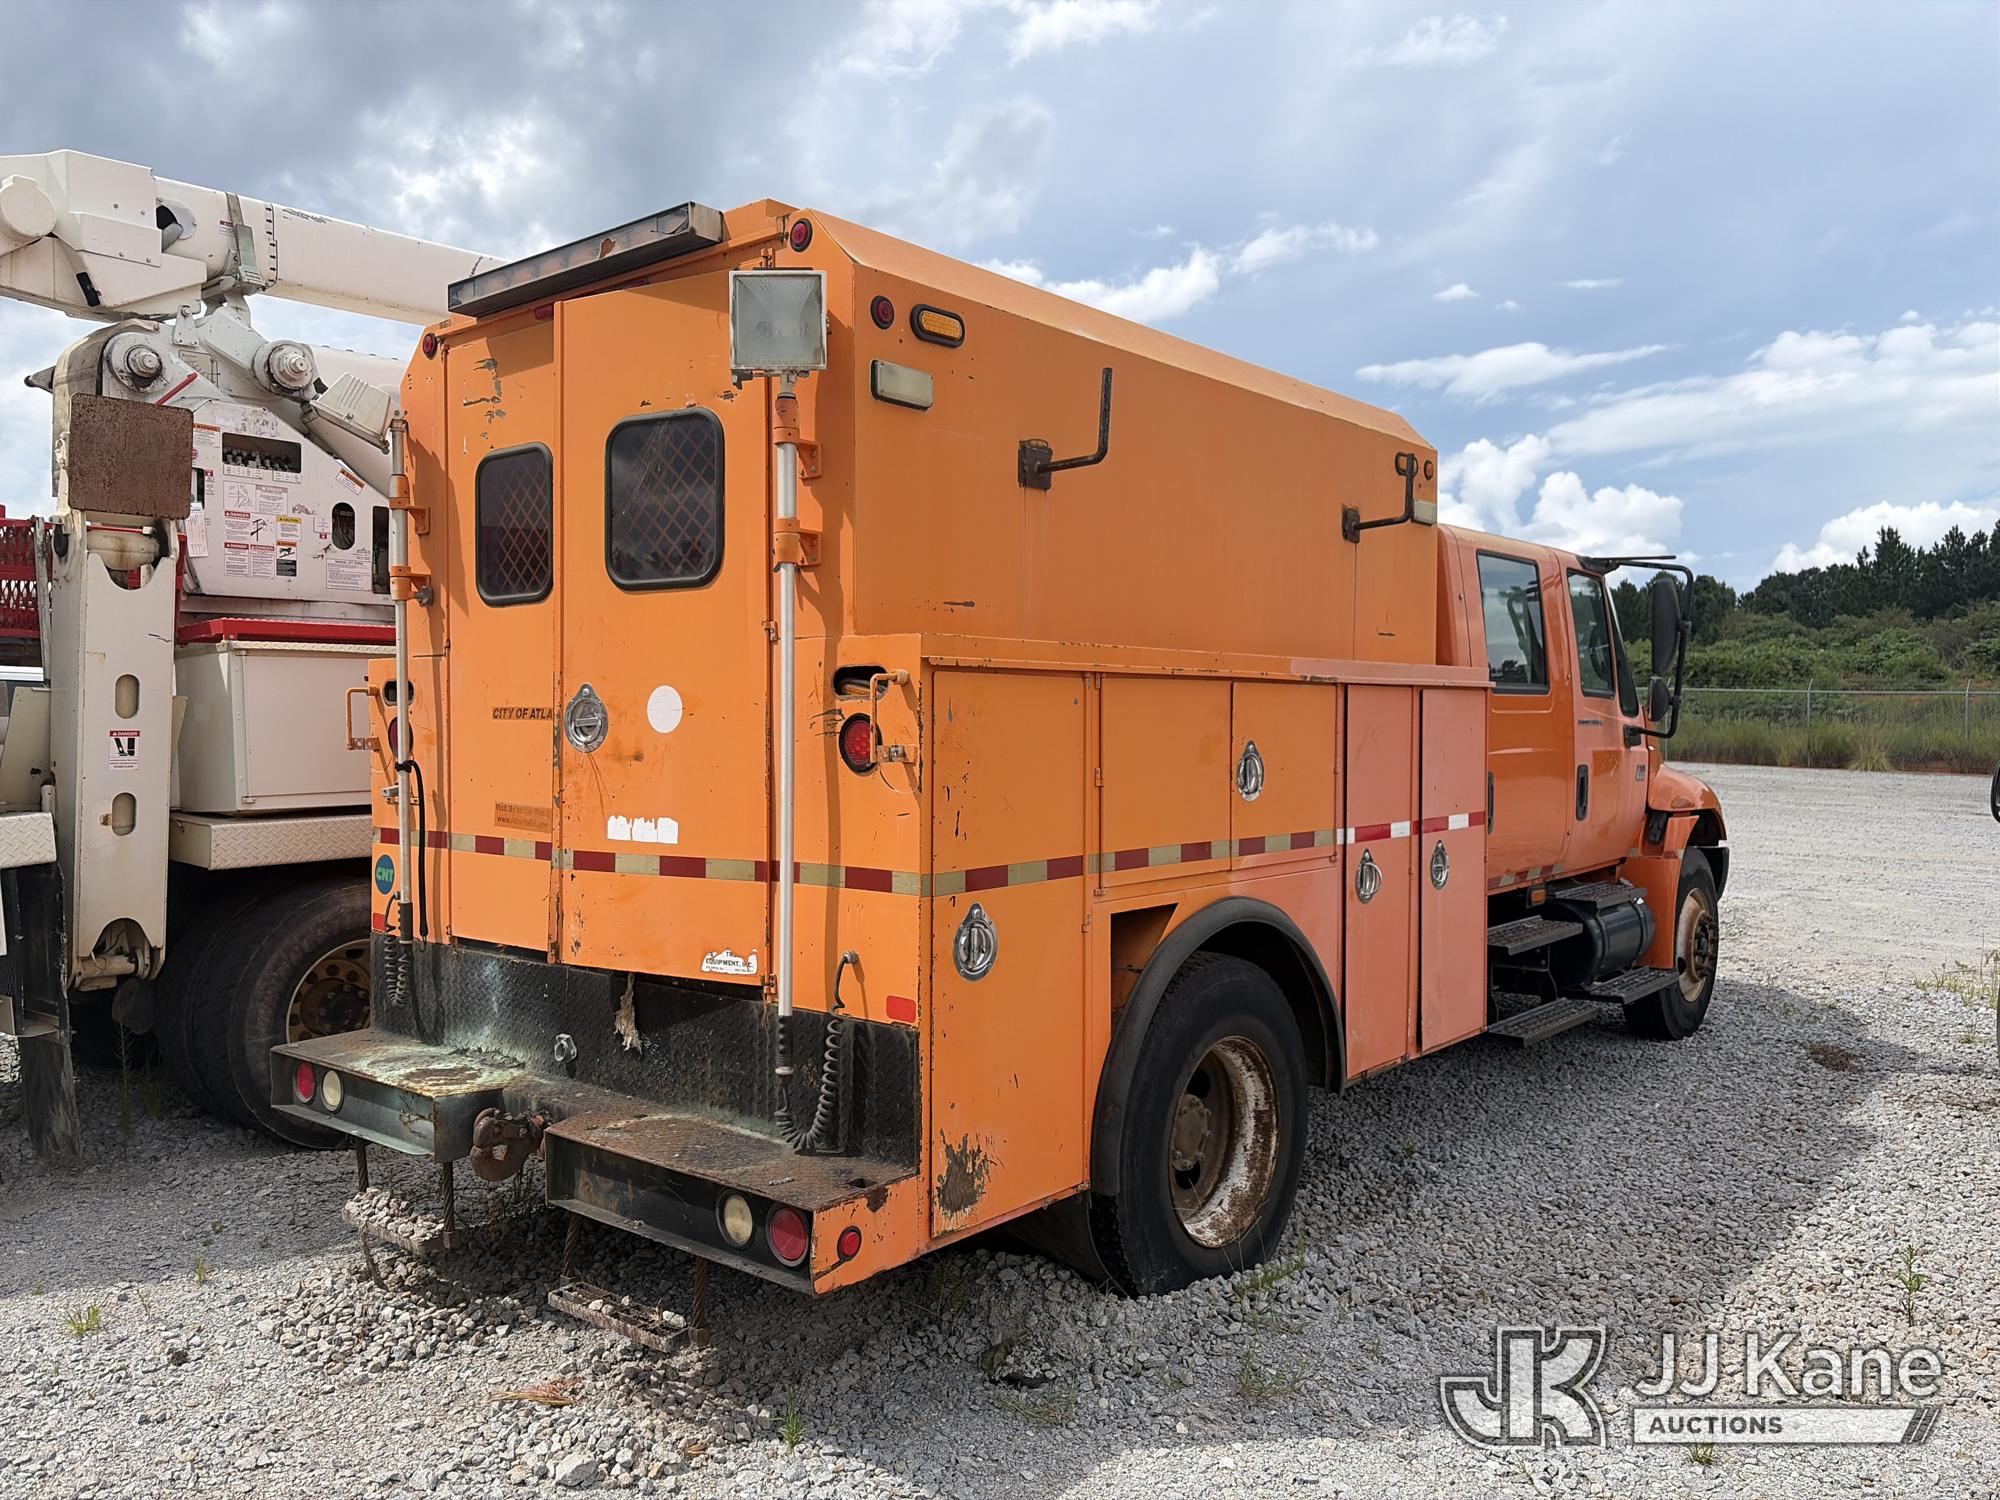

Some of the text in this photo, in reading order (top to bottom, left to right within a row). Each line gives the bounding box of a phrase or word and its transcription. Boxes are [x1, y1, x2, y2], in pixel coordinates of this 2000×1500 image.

[493, 708, 552, 720] CITY OF ATLA
[376, 866, 394, 882] CNT
